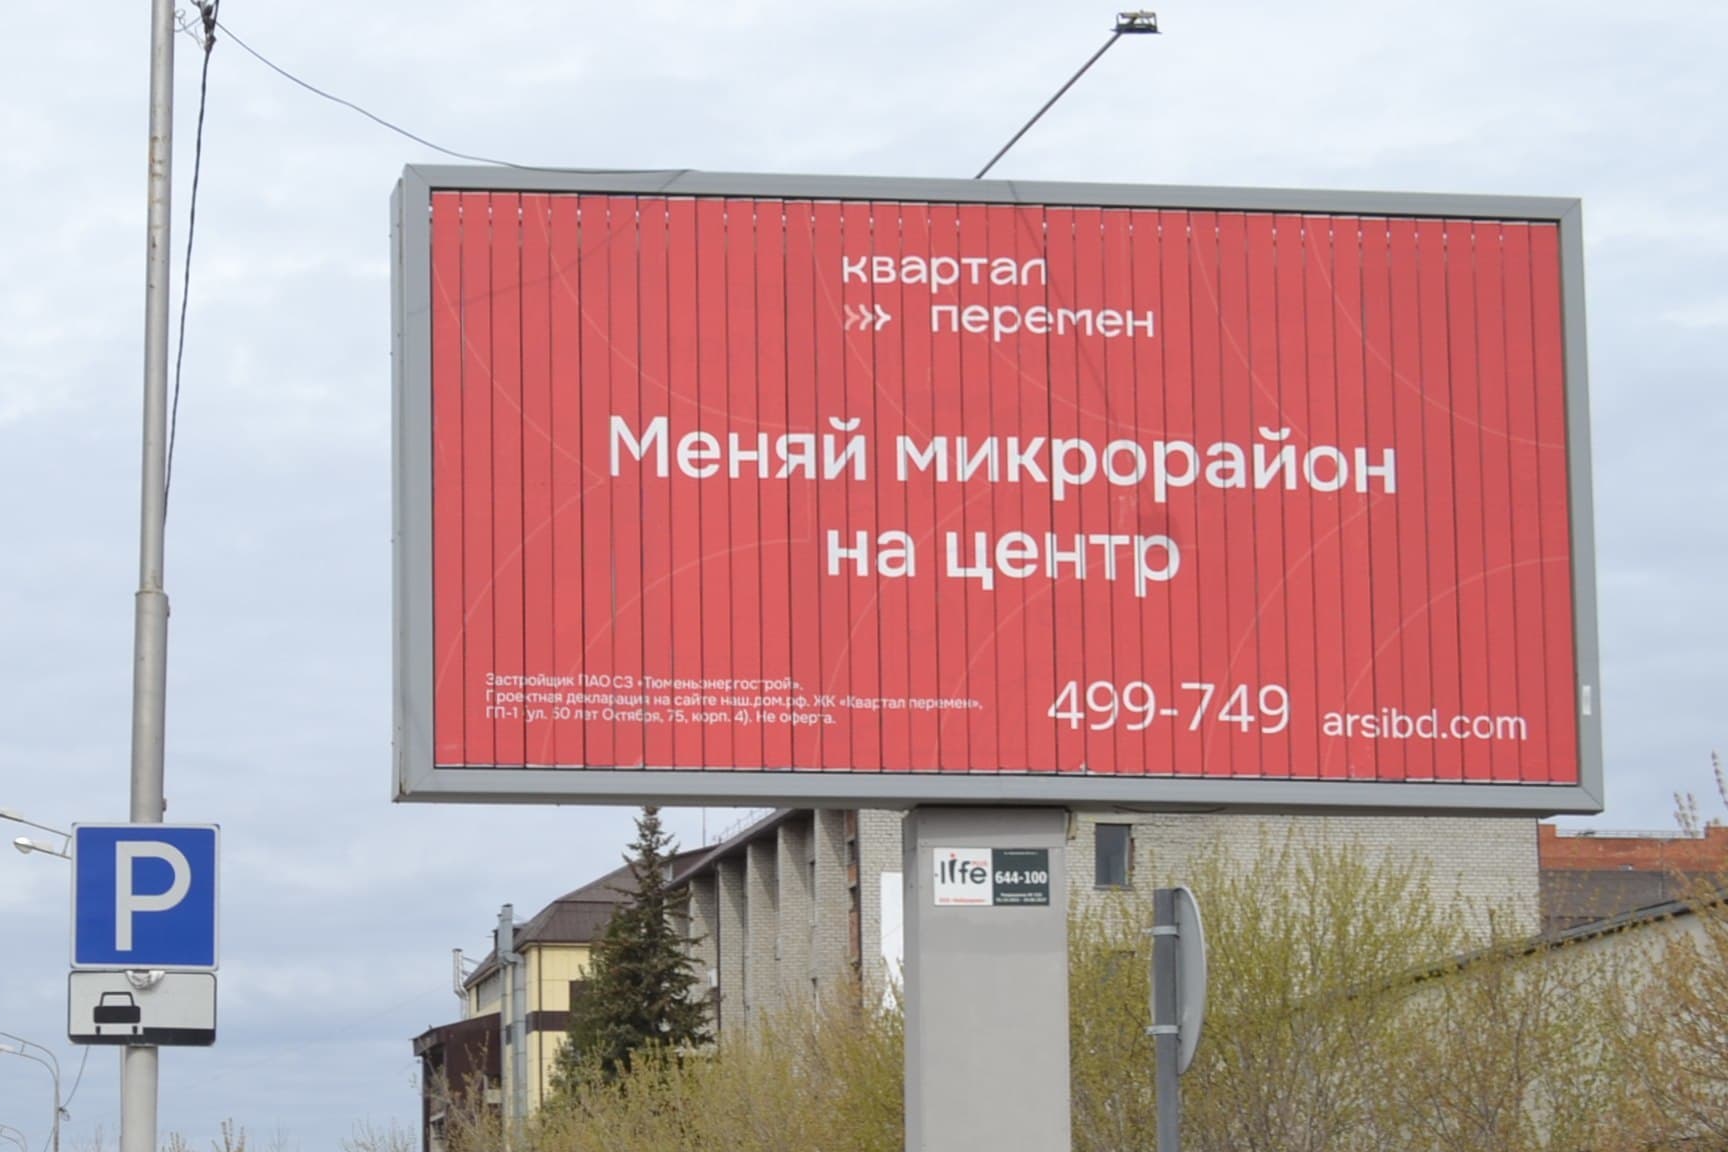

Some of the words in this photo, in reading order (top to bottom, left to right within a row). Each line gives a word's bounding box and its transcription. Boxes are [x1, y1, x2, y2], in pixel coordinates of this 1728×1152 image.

[842, 255, 1047, 294] квартал
[931, 304, 1154, 342] перемен
[609, 415, 867, 481] Меняй
[896, 426, 1398, 503] микрорайон
[826, 526, 917, 578] на
[945, 528, 1181, 597] центр
[485, 672, 574, 688] Застройщик
[578, 674, 611, 688] ПАО
[485, 706, 518, 719] ГП-1
[553, 706, 571, 720] 50
[574, 709, 598, 720] лет
[667, 708, 688, 723] 75,
[692, 711, 731, 724] корп.
[756, 710, 776, 722] Не
[566, 692, 649, 706] декларация
[653, 694, 671, 705] на
[674, 693, 717, 706] сайте
[814, 695, 836, 708] ЖК
[1048, 680, 1291, 735] 499-749
[1322, 707, 1528, 741] arsibd.com
[940, 853, 988, 885] life
[994, 870, 1048, 885] 644-100
[115, 840, 192, 951] P
